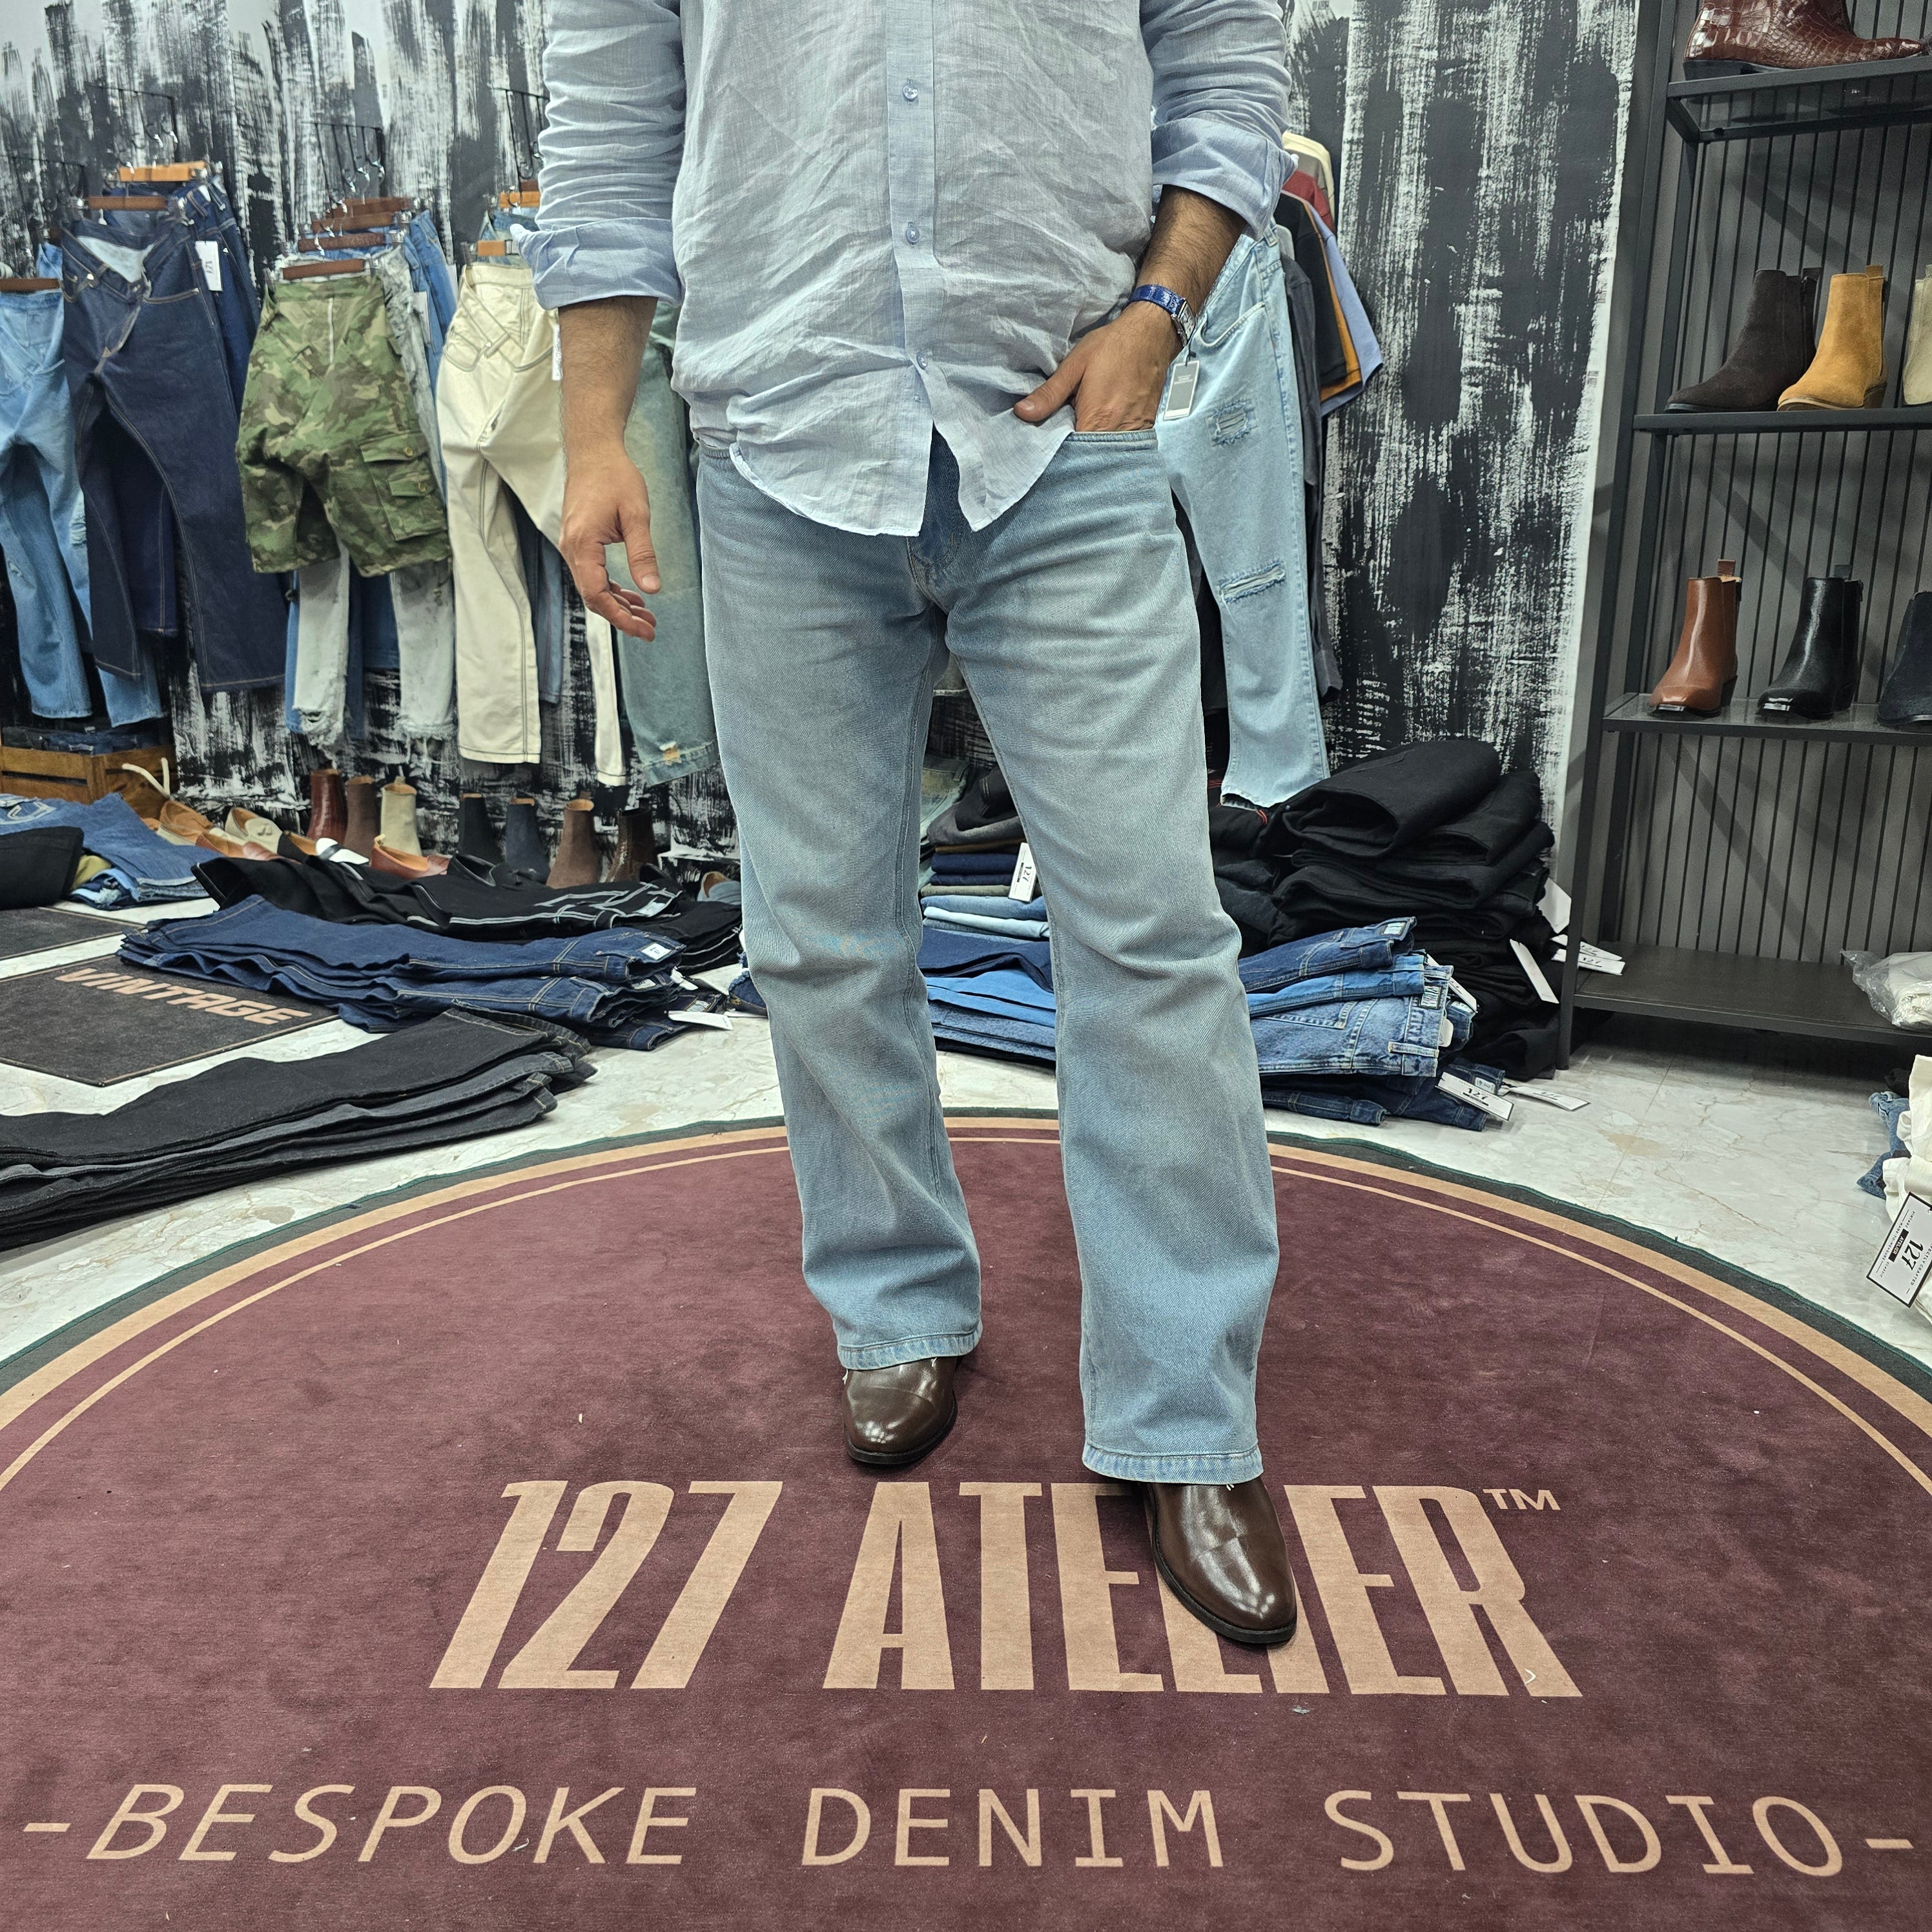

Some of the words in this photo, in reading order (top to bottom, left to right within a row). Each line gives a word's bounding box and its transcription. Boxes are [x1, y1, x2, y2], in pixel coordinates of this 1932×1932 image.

[1022, 865, 1032, 882] 127
[55, 968, 312, 1025] VINTAGE
[1468, 1087, 1488, 1100] 127
[1892, 1236, 1904, 1255] ATELIER
[1901, 1239, 1924, 1271] 127
[1910, 1264, 1924, 1286] CRAFTED
[429, 1480, 783, 1689] 127
[801, 1787, 1224, 1867] DENIM
